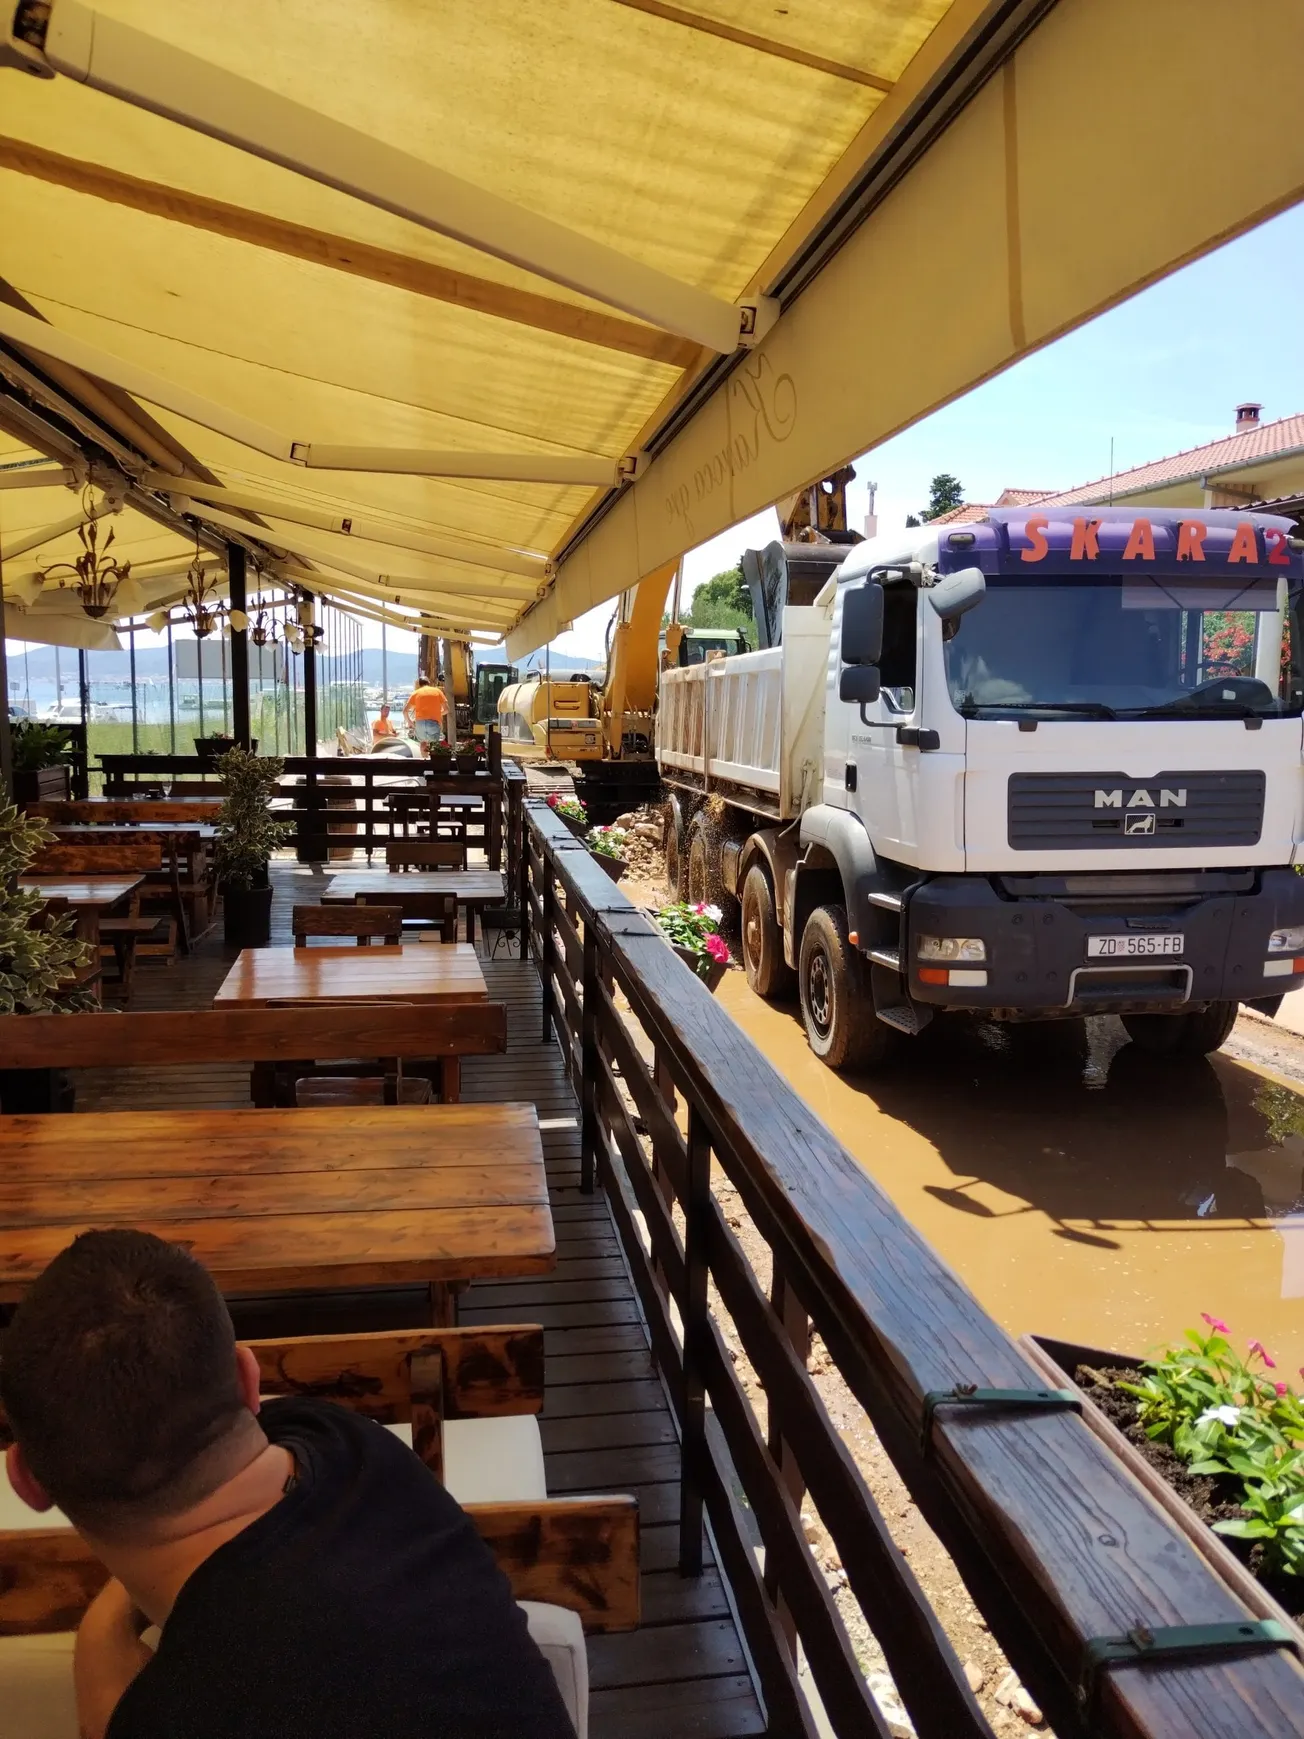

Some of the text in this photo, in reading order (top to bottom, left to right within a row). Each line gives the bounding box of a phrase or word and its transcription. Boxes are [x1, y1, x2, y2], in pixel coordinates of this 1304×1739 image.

[1094, 789, 1187, 808] MAN
[1098, 936, 1182, 955] ZD 565-FB
